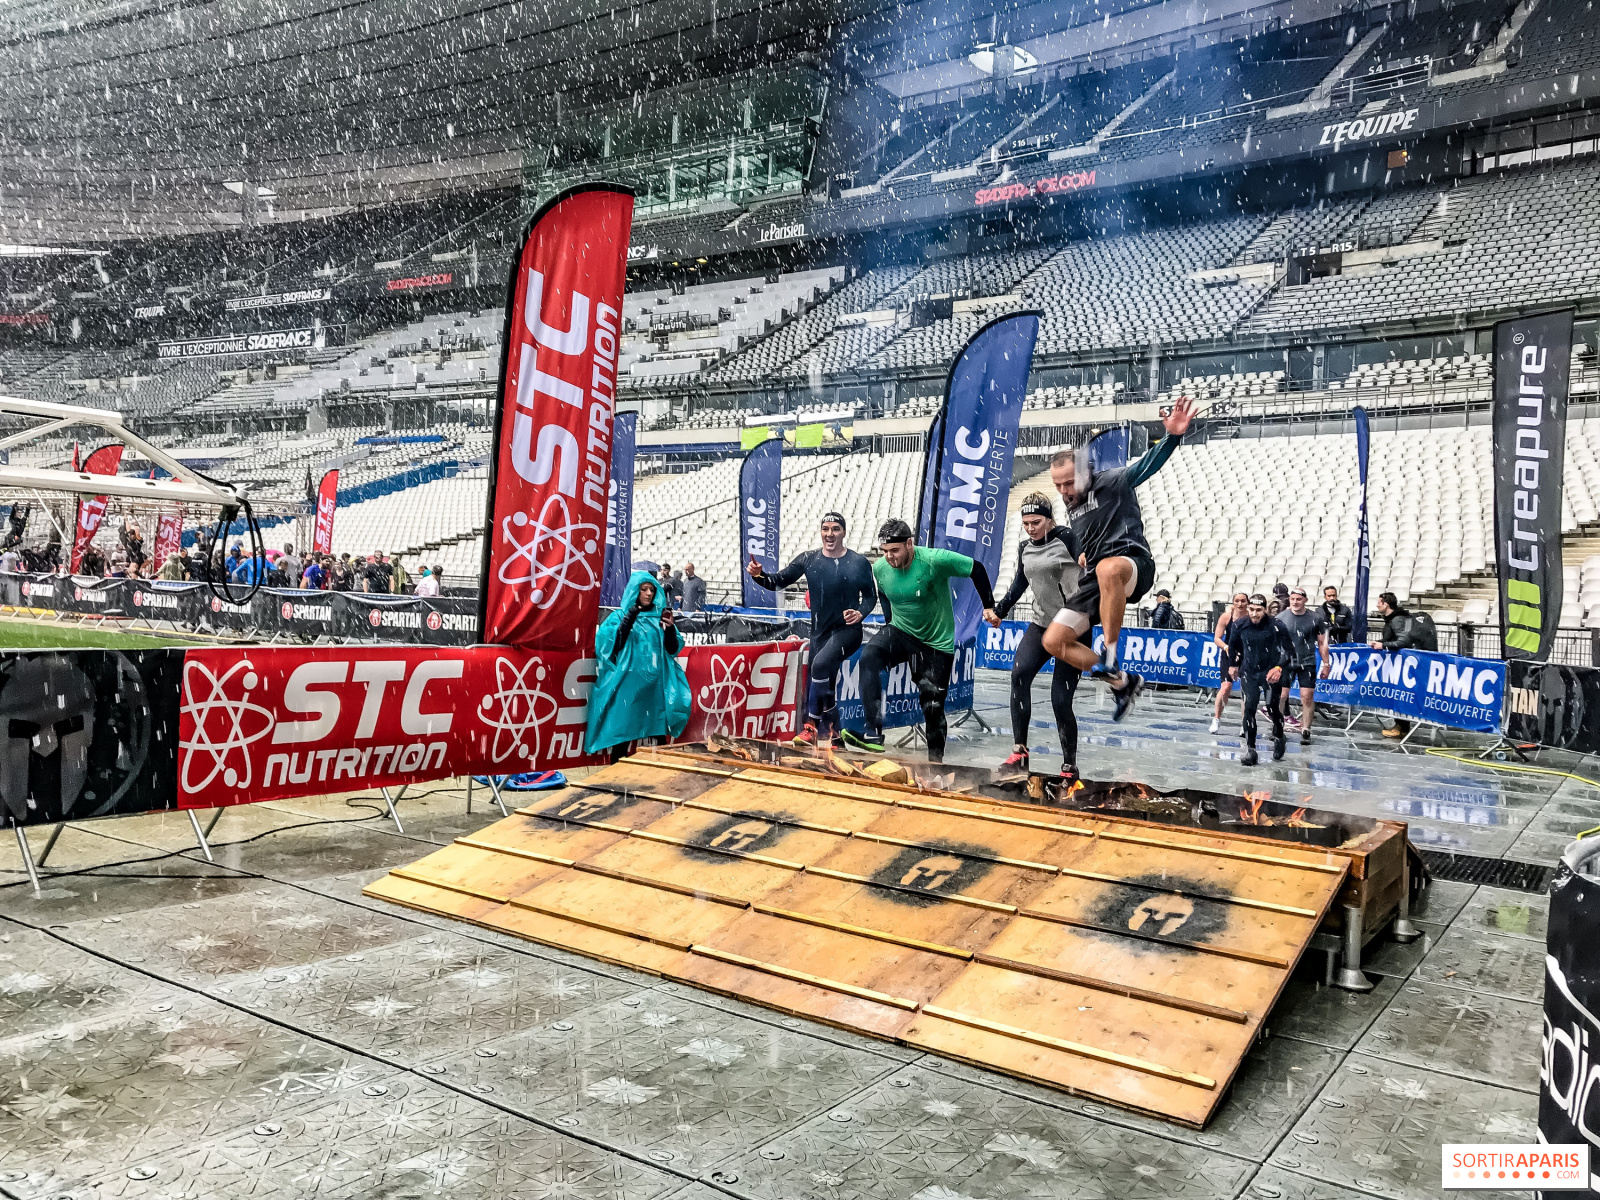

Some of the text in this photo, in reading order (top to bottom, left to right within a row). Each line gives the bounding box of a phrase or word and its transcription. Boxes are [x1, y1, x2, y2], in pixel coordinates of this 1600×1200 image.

[158, 331, 311, 357] VIVRE L'EXCEPTIONNEL STADEFRANCE
[511, 267, 590, 498] STC
[944, 425, 990, 542] RMC
[981, 429, 1008, 547] DÉCOUVERTE
[316, 493, 328, 547] STC
[746, 497, 767, 557] RMC
[142, 592, 178, 609] SPARTAN
[293, 604, 332, 621] SPARTAN
[381, 611, 422, 629] SPARTAN
[985, 627, 1024, 652] RM
[1123, 635, 1190, 665] RMC
[1121, 662, 1187, 677] DÉCOUVERTE
[1364, 652, 1418, 690] RMC
[1426, 660, 1499, 705] RMC
[271, 660, 464, 745] STC
[1423, 695, 1494, 722] DÉCOUVERTE
